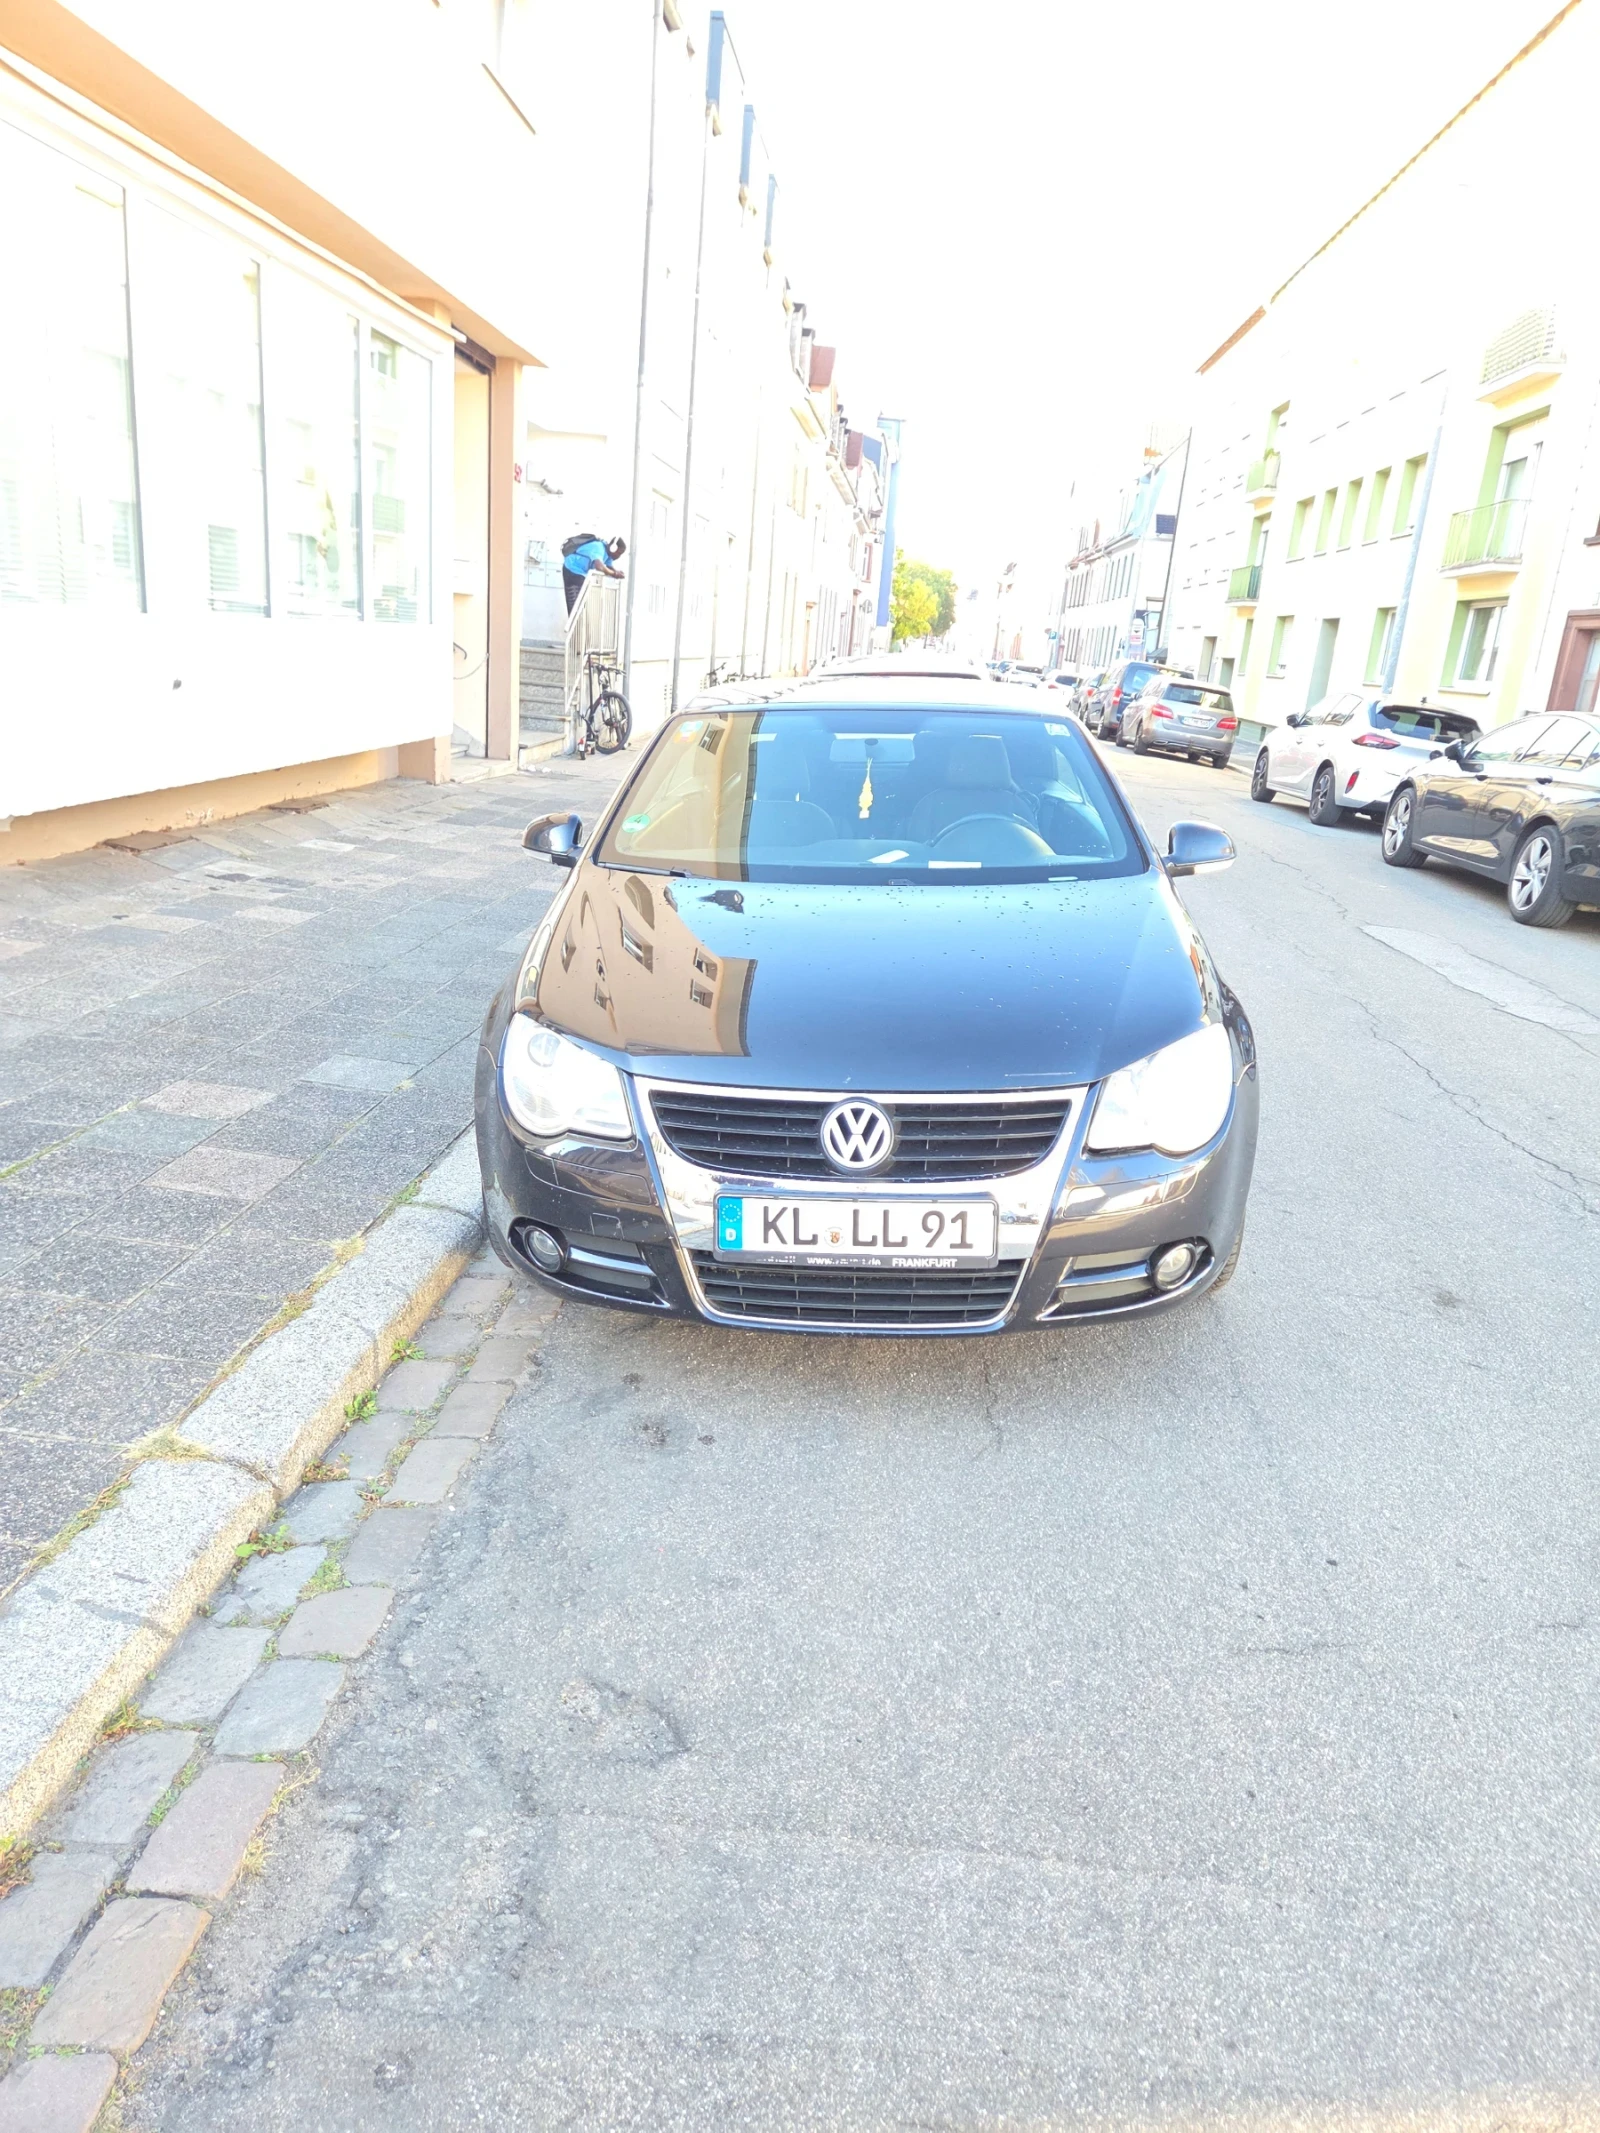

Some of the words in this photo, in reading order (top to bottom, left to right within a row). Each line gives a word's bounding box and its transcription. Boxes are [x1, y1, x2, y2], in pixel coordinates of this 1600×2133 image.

[824, 1102, 890, 1168] VW
[725, 1228, 736, 1241] D
[763, 1206, 818, 1245] KL
[853, 1209, 908, 1248] LL
[921, 1210, 973, 1249] 91
[892, 1258, 957, 1268] FRANKFURT
